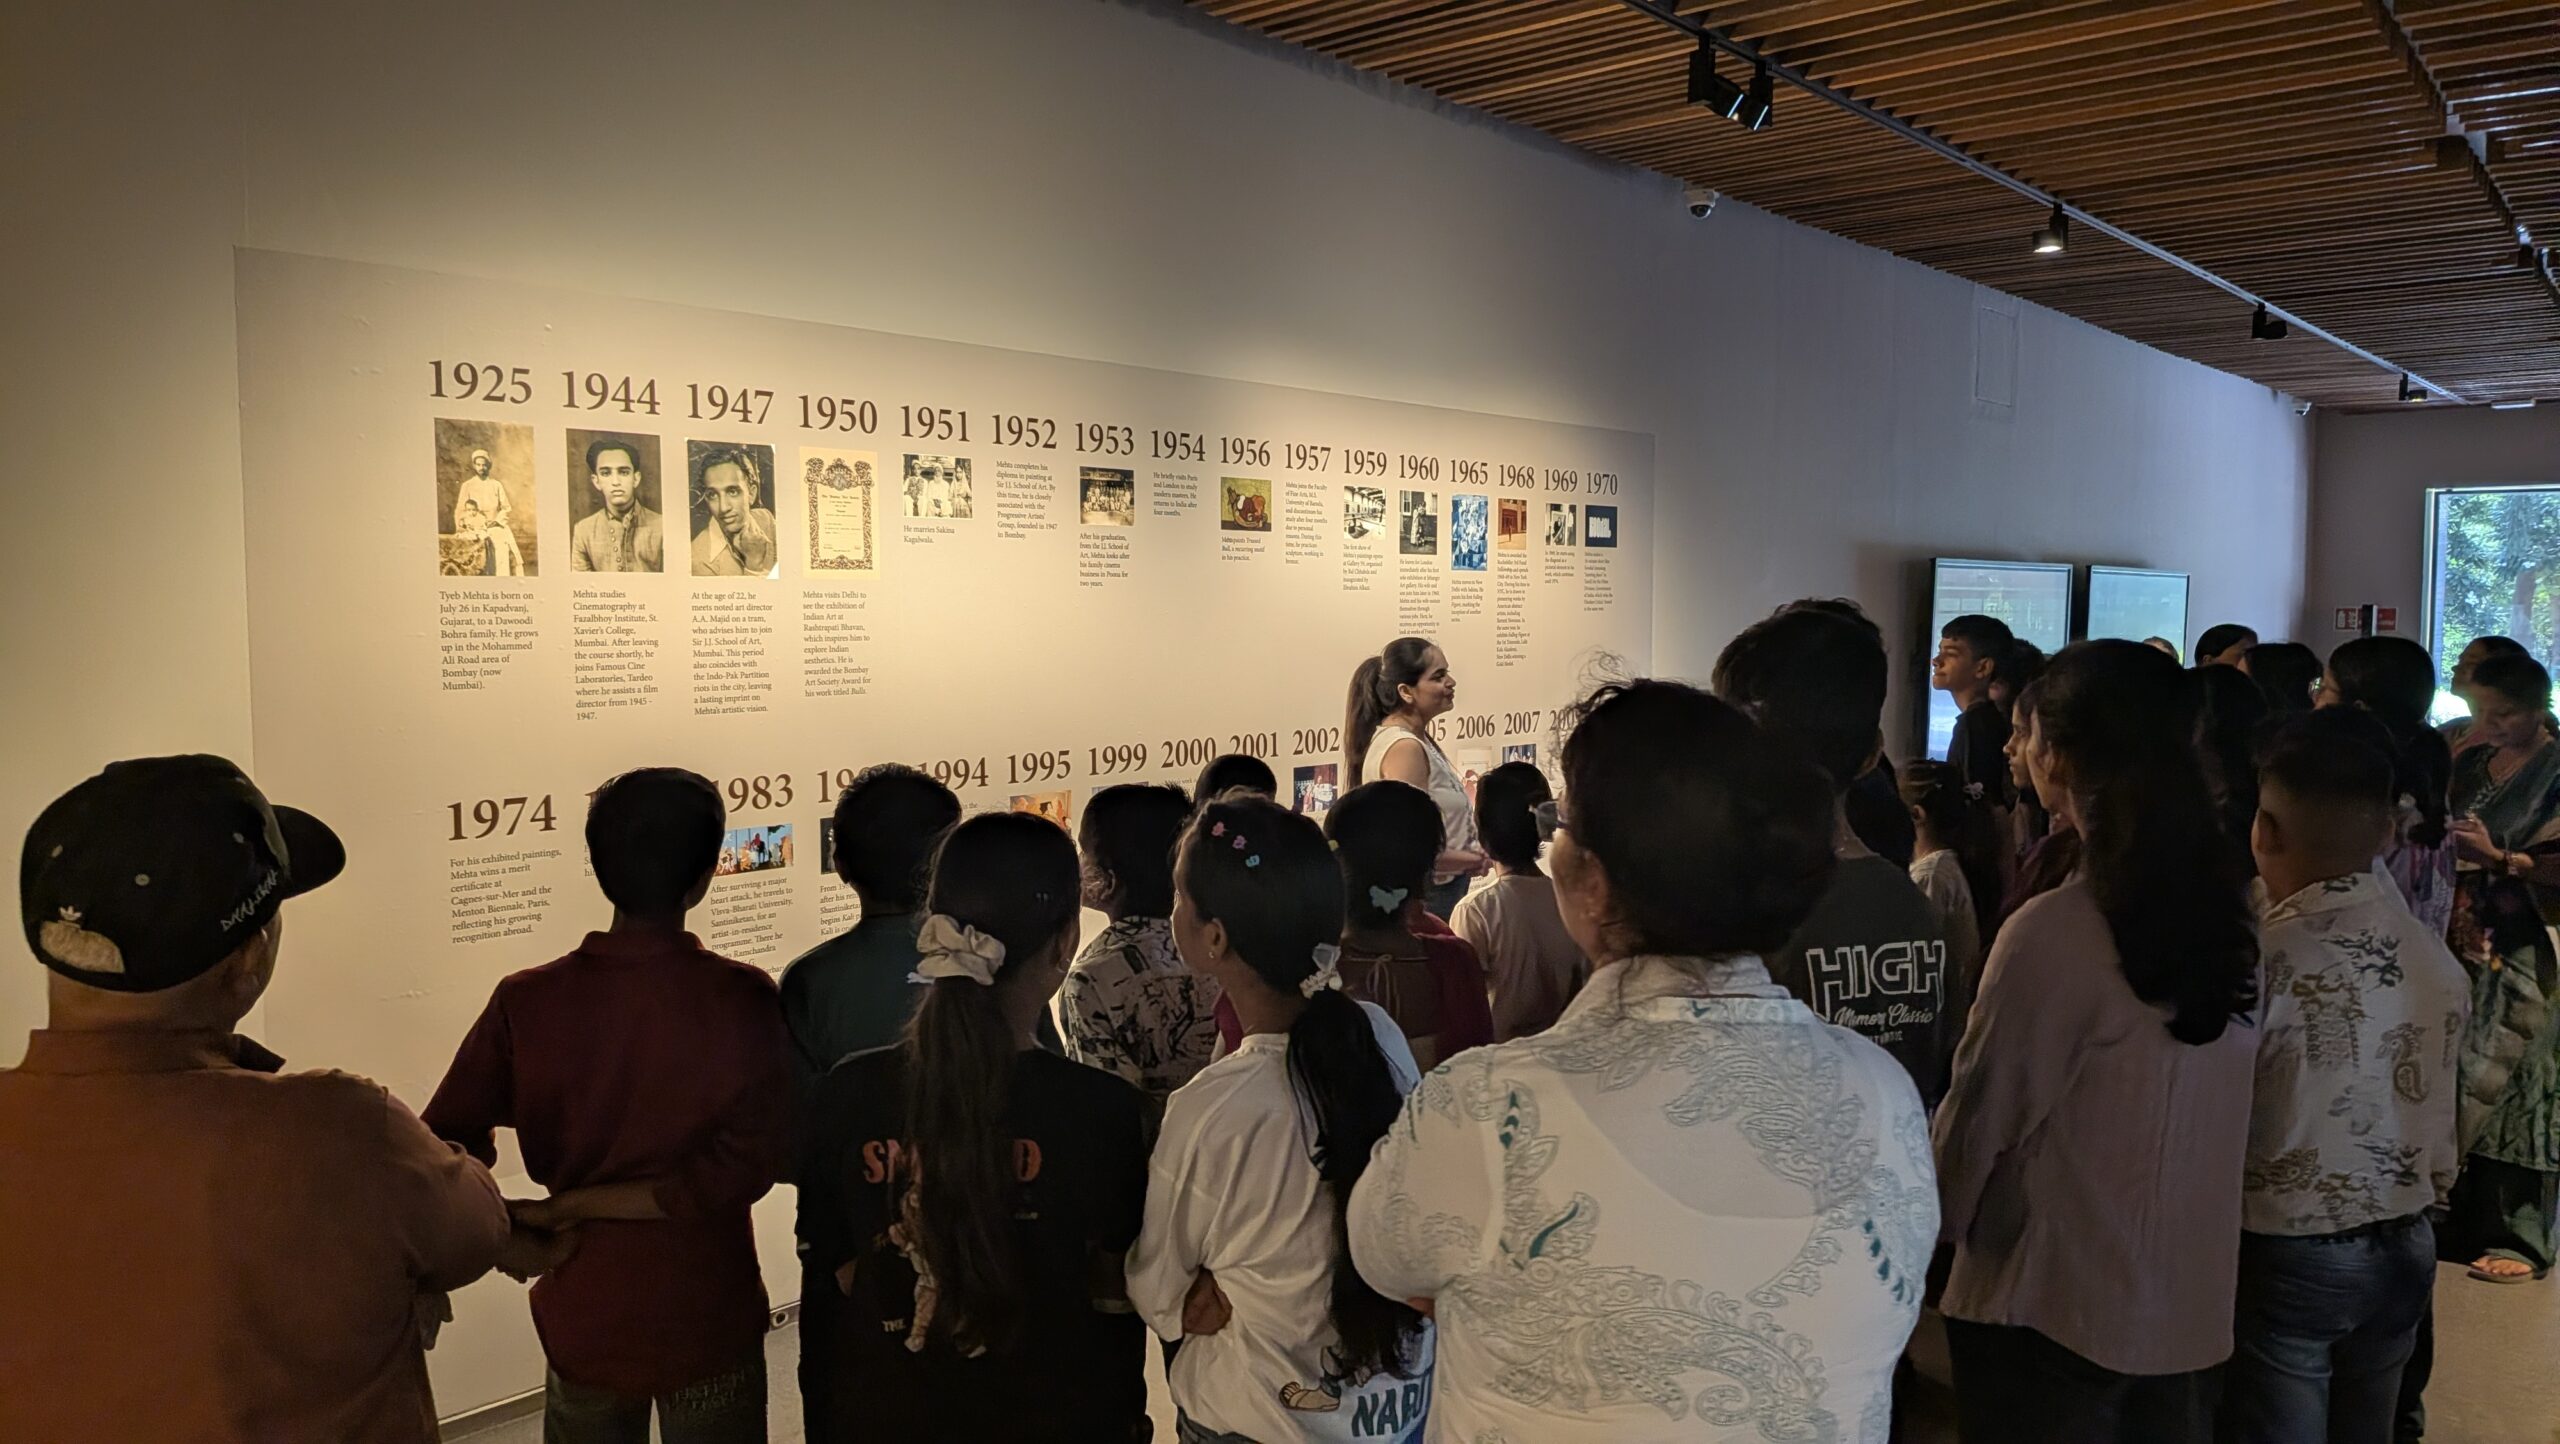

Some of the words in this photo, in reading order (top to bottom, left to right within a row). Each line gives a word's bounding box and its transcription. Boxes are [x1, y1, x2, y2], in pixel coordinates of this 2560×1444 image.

[429, 360, 532, 404] 1925
[561, 371, 661, 415] 1944
[686, 383, 774, 425] 1947
[798, 394, 878, 434] 1950
[900, 405, 970, 442] 1951
[992, 414, 1057, 449] 1952
[1075, 422, 1134, 456] 1953
[1151, 430, 1206, 462] 1954
[1220, 436, 1271, 467] 1956
[1285, 443, 1331, 472] 1957
[1344, 449, 1387, 477] 1959
[1399, 454, 1440, 481] 1960
[1450, 459, 1488, 485] 1965
[1499, 464, 1535, 489] 1968
[1544, 468, 1578, 492] 1969
[1586, 472, 1618, 495] 1970
[439, 591, 461, 603] Tyeb
[463, 592, 490, 600] Mehta
[492, 591, 499, 600] is
[501, 591, 520, 600] born
[573, 590, 597, 598] Mehta
[600, 590, 626, 598] studies
[691, 592, 700, 600] At
[701, 592, 713, 600] the
[714, 593, 726, 601] age
[727, 592, 735, 600] of
[736, 592, 746, 600] 22,
[748, 592, 756, 600] he
[440, 604, 456, 614] July
[472, 604, 480, 612] in
[573, 603, 636, 612] Cinematography
[440, 617, 475, 628] Gujarat,
[495, 617, 533, 625] Dawoodi
[573, 614, 612, 624] Fazalbhoy
[614, 614, 647, 623] Institute,
[649, 614, 658, 622] St.
[441, 630, 467, 639] Bohra
[469, 630, 498, 640] family.
[500, 630, 512, 638] He
[514, 631, 539, 640] grows
[605, 626, 636, 636] College,
[441, 645, 453, 653] up
[455, 643, 464, 651] in
[466, 643, 480, 651] the
[482, 642, 532, 650] Mohammed
[574, 638, 608, 647] Mumbai.
[611, 638, 630, 647] After
[632, 638, 659, 648] leaving
[442, 656, 455, 665] Ali
[457, 655, 480, 664] Road
[501, 654, 511, 663] of
[575, 651, 587, 660] the
[616, 650, 644, 660] shortly,
[645, 650, 654, 658] he
[442, 668, 477, 679] Bombay
[480, 668, 502, 678] (now
[575, 663, 594, 673] joins
[596, 663, 625, 671] Famous
[627, 662, 645, 670] Cine
[443, 681, 485, 691] Mumbai).
[576, 675, 625, 684] Laboratories,
[627, 674, 653, 682] Tardeo
[576, 687, 599, 696] where
[601, 687, 610, 695] he
[612, 686, 635, 695] assists
[643, 685, 658, 693] film
[576, 699, 607, 709] director
[609, 698, 627, 707] from
[629, 698, 647, 706] 1945
[576, 711, 597, 720] 1947.
[1504, 711, 1540, 735] 2007
[1456, 714, 1495, 739] 2006
[1230, 732, 1279, 758] 2001
[1293, 727, 1340, 755] 2002
[1088, 743, 1147, 776] 1999
[1161, 737, 1216, 768] 2000
[1007, 750, 1071, 784] 1995
[712, 774, 793, 813] 983
[447, 794, 557, 841] 1974
[450, 859, 464, 867] For
[467, 856, 480, 865] his
[481, 852, 520, 864] exhibited
[522, 849, 562, 861] paintings,
[451, 870, 478, 880] Mehta
[480, 868, 500, 876] wins
[508, 864, 531, 873] merit
[451, 881, 492, 892] certificate
[711, 885, 728, 894] After
[730, 880, 761, 890] surviving
[768, 878, 787, 887] major
[820, 885, 837, 893] From
[451, 891, 519, 907] Cagnes-sur-Mer
[521, 887, 537, 896] and
[539, 886, 552, 894] the
[710, 896, 728, 905] heart
[730, 893, 752, 902] attack,
[763, 888, 784, 897] travels
[820, 896, 834, 904] after
[452, 907, 485, 918] Menton
[487, 901, 525, 914] Biennale,
[711, 902, 757, 916] Visva-Bharati
[452, 919, 492, 931] reflecting
[494, 916, 506, 925] his
[508, 912, 542, 926] growing
[711, 916, 756, 928] Santiniketan,
[820, 917, 840, 925] begins
[452, 931, 501, 944] recognition
[503, 924, 534, 936] abroad.
[711, 924, 773, 939] artist-in-residence
[820, 928, 833, 936] Kali
[712, 938, 752, 950] programme.
[754, 934, 773, 942] There
[733, 944, 776, 957] Ramchandra
[1806, 940, 1946, 1022] HIGH
[1888, 1003, 1934, 1026] Classic
